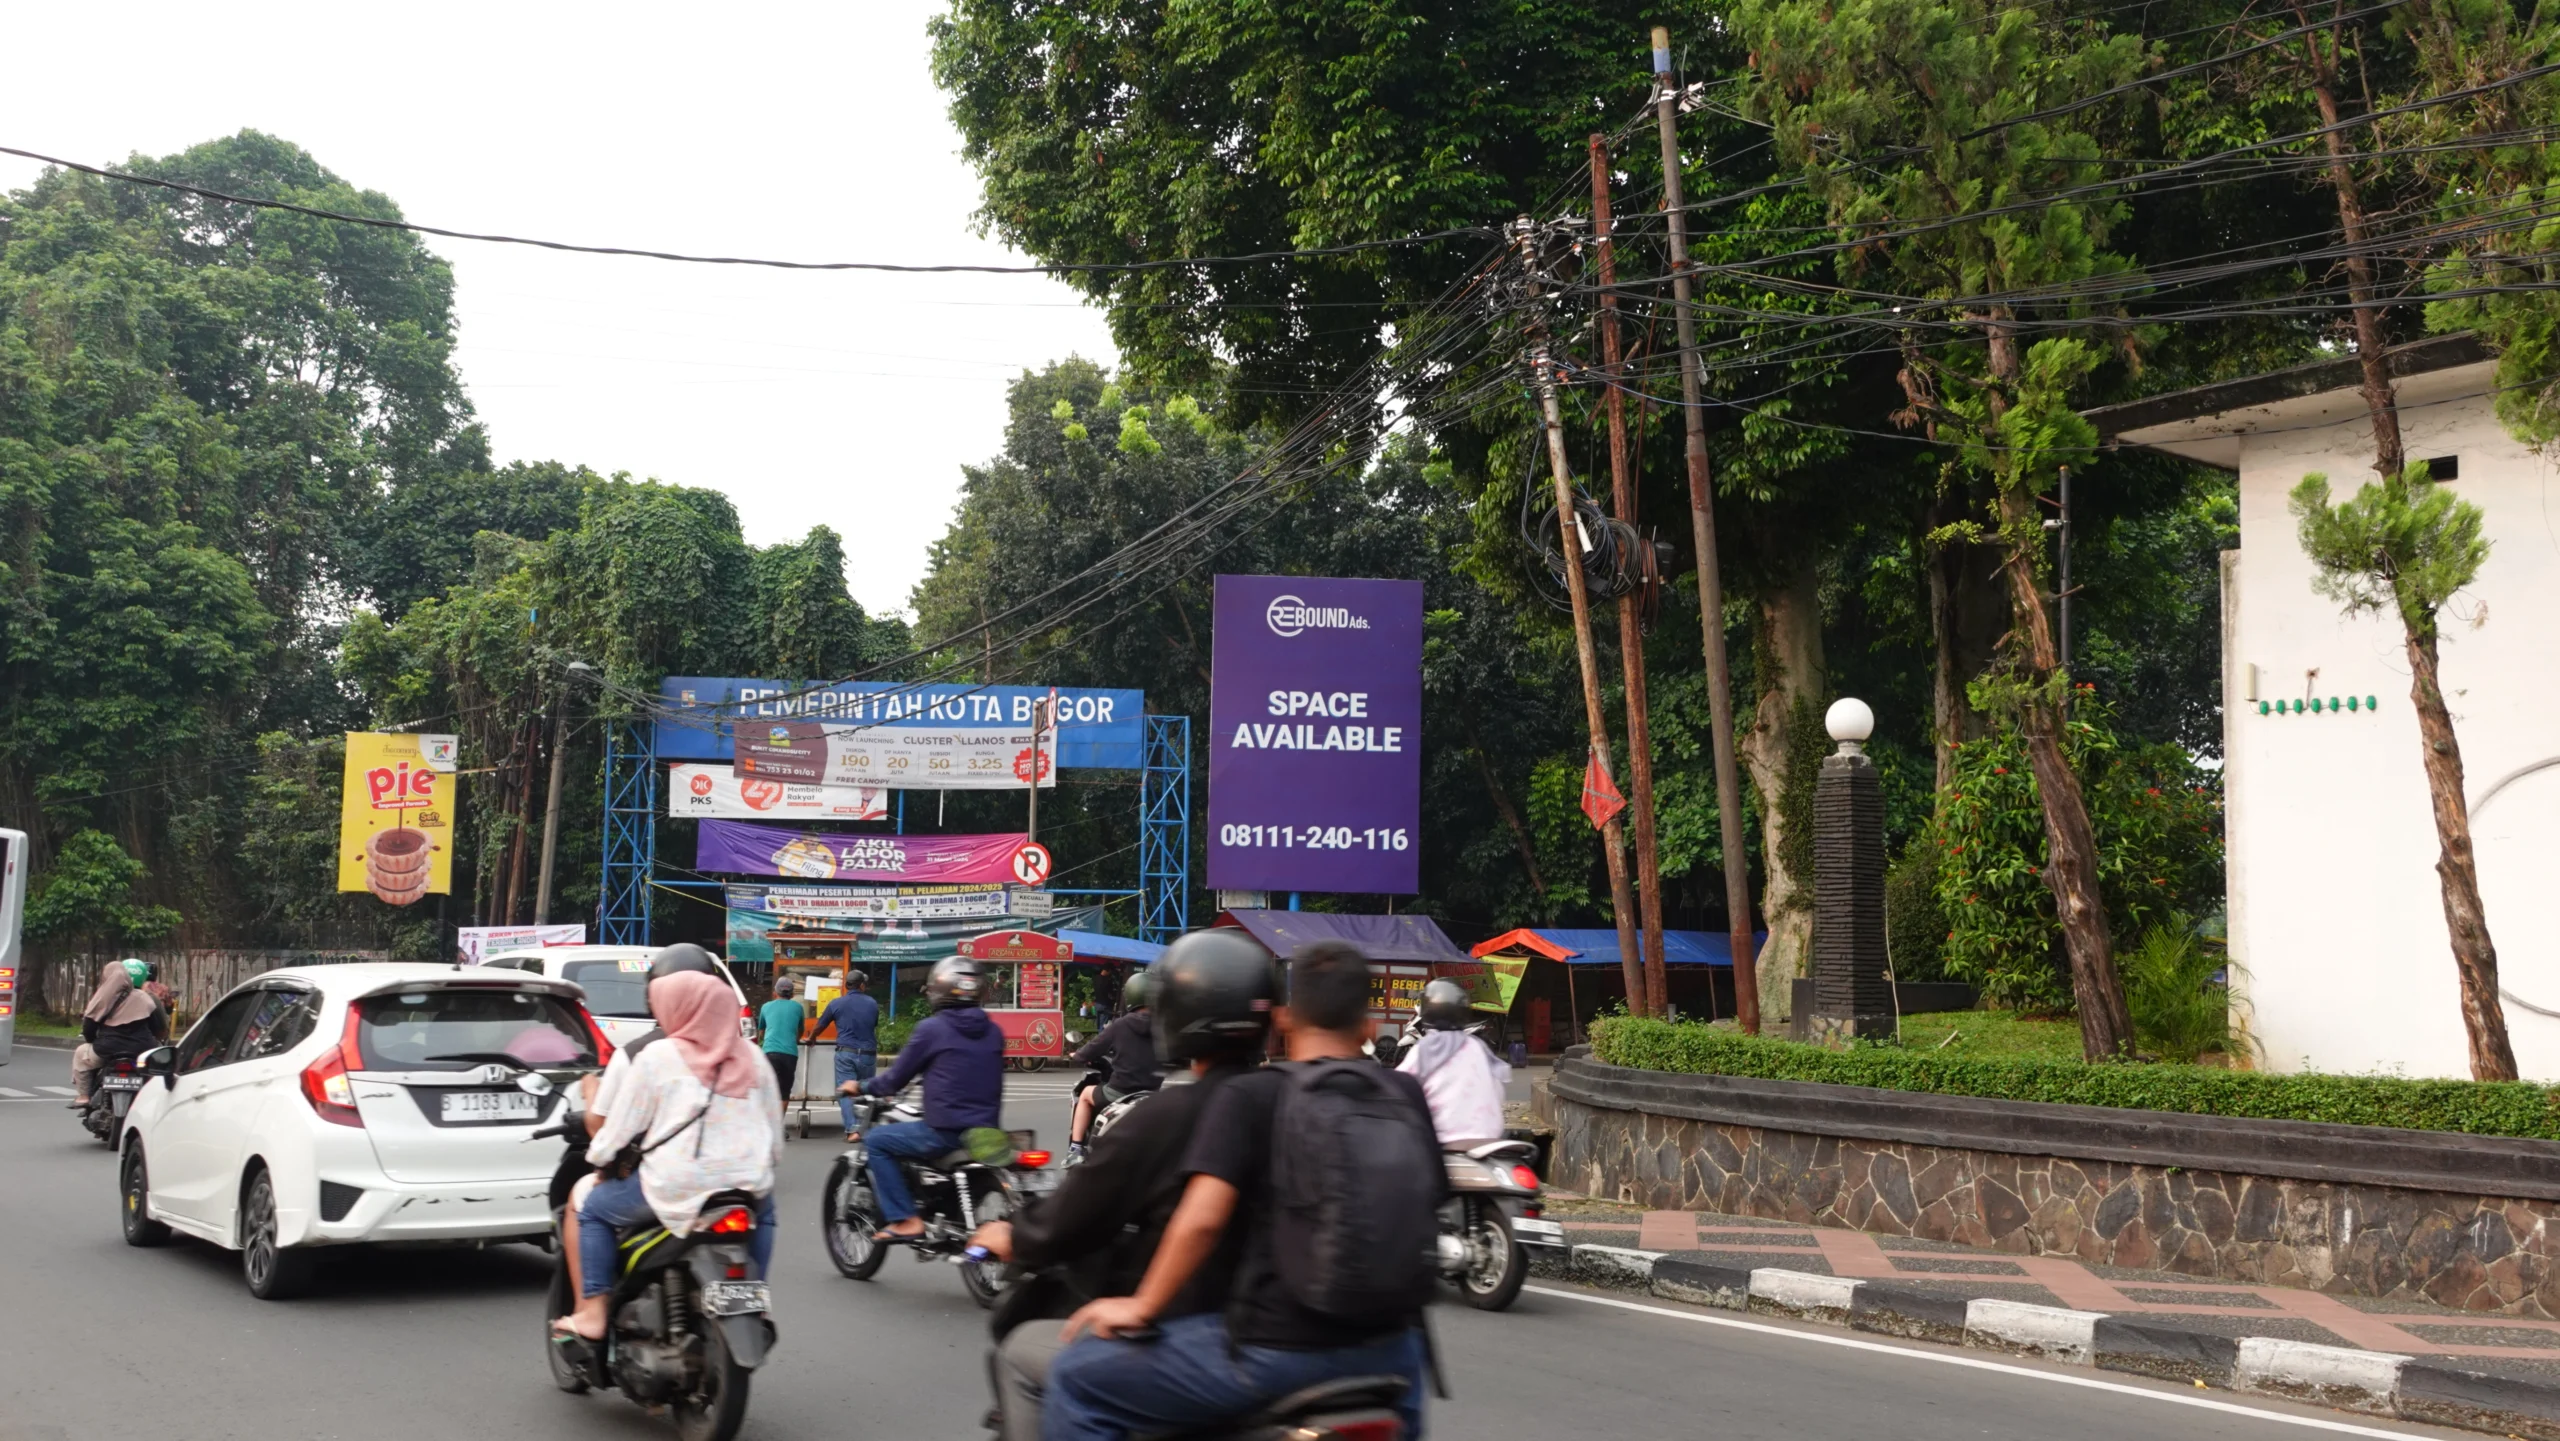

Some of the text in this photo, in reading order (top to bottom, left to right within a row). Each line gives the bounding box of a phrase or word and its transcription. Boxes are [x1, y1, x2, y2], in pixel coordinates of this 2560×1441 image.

[1270, 605, 1371, 629] REBOUND Ads.
[740, 688, 922, 720] PEMERINTAH
[929, 694, 1002, 722] KOTA
[1268, 690, 1368, 718] SPACE
[903, 736, 953, 745] CLUSTER
[961, 736, 1005, 745] LLANOS
[1231, 723, 1402, 752] AVAILABLE
[841, 754, 870, 767] 190
[887, 757, 909, 768] 20
[929, 758, 951, 769] 50
[967, 758, 1003, 770] 3.25
[766, 765, 781, 773] 753
[794, 767, 816, 777] 01/02
[365, 762, 437, 805] pie
[835, 776, 857, 784] FREE
[857, 777, 890, 785] CANOPY
[690, 797, 712, 805] PKS
[853, 838, 895, 849] AKU
[1220, 824, 1409, 851] 08111-240-116
[840, 847, 906, 862] LAPOR
[841, 858, 905, 873] PAJAK
[769, 886, 818, 896] PENERIMAAN
[819, 888, 852, 896] PESERTA
[853, 888, 875, 896] DIDIK
[875, 888, 897, 896] BARU
[898, 887, 915, 895] THN.
[916, 885, 958, 895] PELAJARAN
[959, 883, 1003, 892] 2024/2025
[779, 898, 794, 906] SMK
[811, 899, 839, 907] DHARMA
[1392, 979, 1426, 991] BEBEK
[441, 1094, 452, 1111] B
[461, 1093, 501, 1111] 1183
